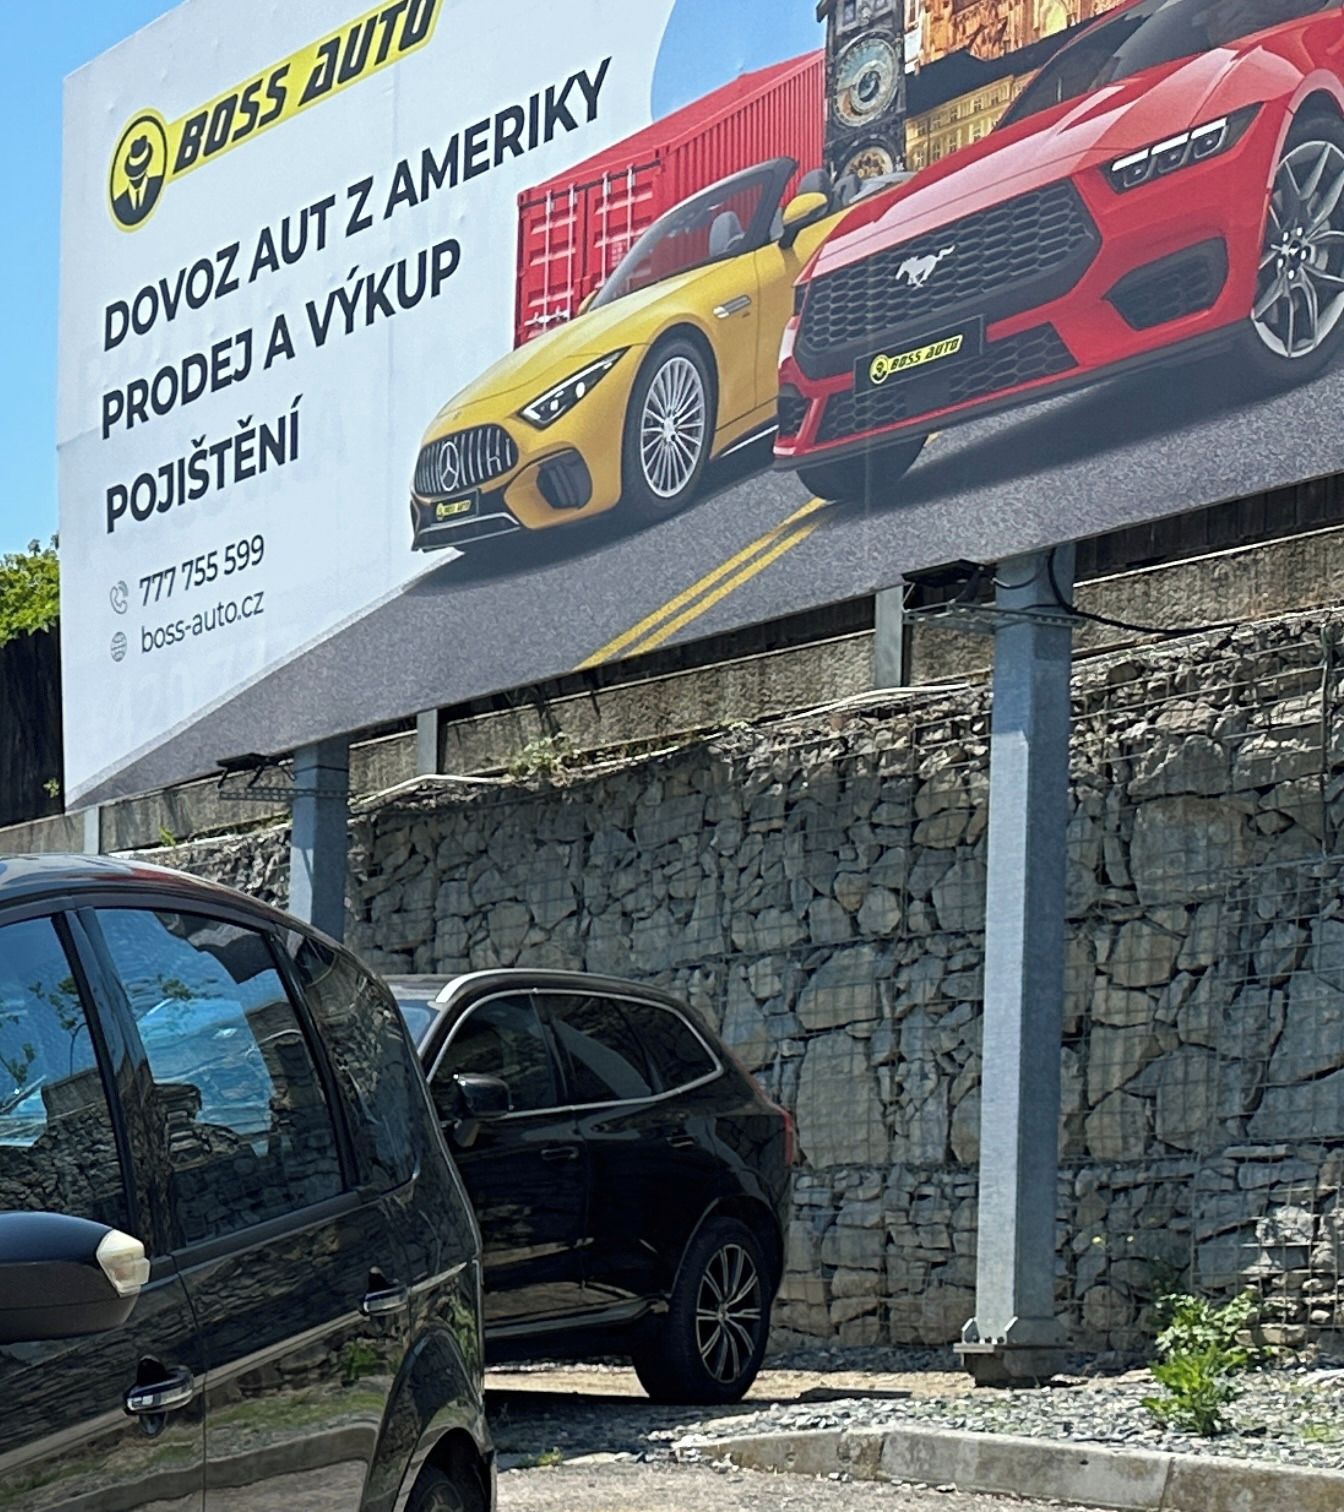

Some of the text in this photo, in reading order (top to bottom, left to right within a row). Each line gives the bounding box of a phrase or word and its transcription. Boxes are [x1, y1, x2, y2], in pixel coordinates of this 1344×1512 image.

[173, 0, 436, 175] BOSS AUTO
[103, 57, 612, 352] DOVOZ AUT Z AMERIKY
[100, 239, 461, 439] PRODEJ A VÝKUP
[106, 393, 303, 534] POJIŠTĚNÍ
[139, 534, 264, 607] 777 755 599
[141, 591, 264, 653] boss-auto.cz
